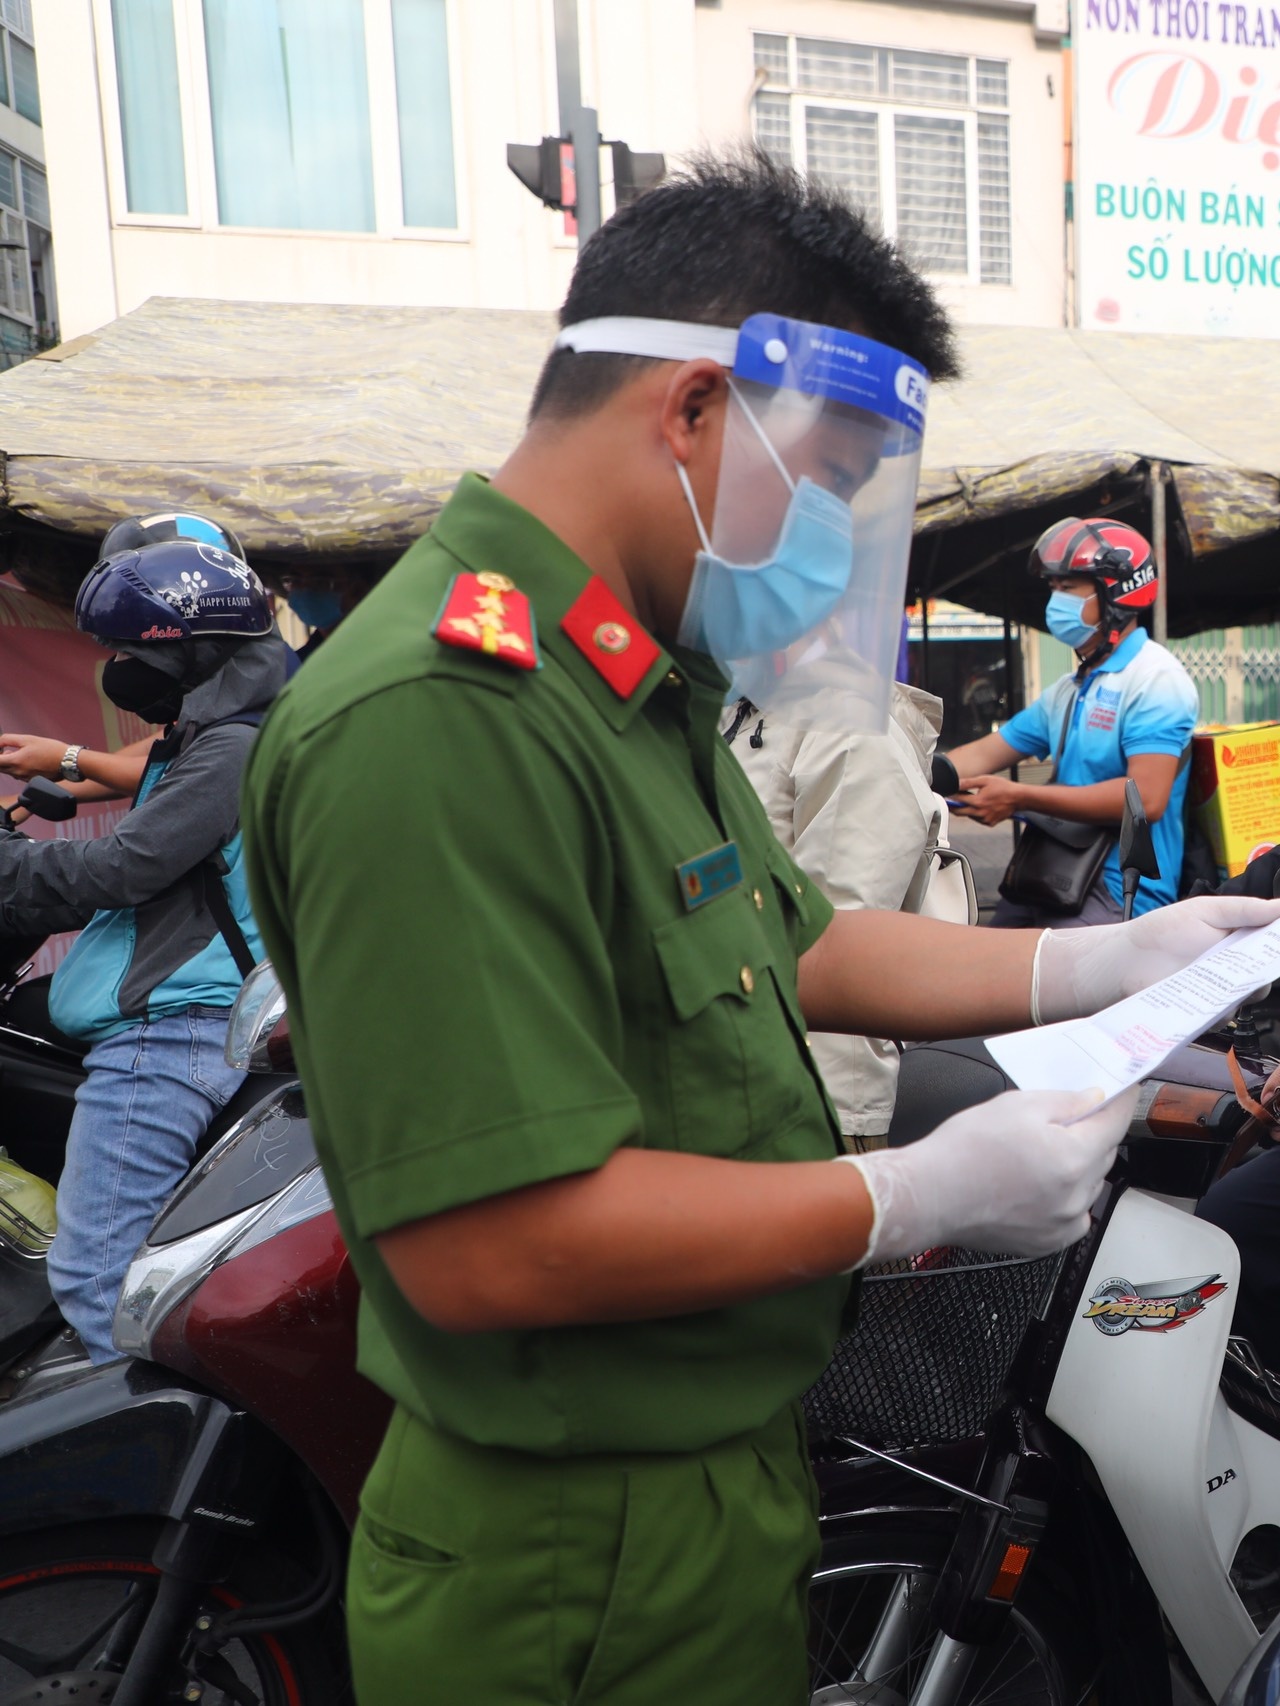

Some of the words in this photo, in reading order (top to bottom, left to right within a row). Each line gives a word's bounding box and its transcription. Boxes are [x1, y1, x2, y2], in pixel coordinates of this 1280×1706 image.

[1095, 177, 1186, 223] BUÔN
[1200, 183, 1265, 228] BÁN
[1127, 232, 1170, 281] SỐ
[199, 596, 225, 607] HAPPY
[226, 596, 252, 607] EASTER
[141, 625, 183, 639] Asia
[1101, 1279, 1128, 1289] FAMILY
[193, 1507, 229, 1520] Combi
